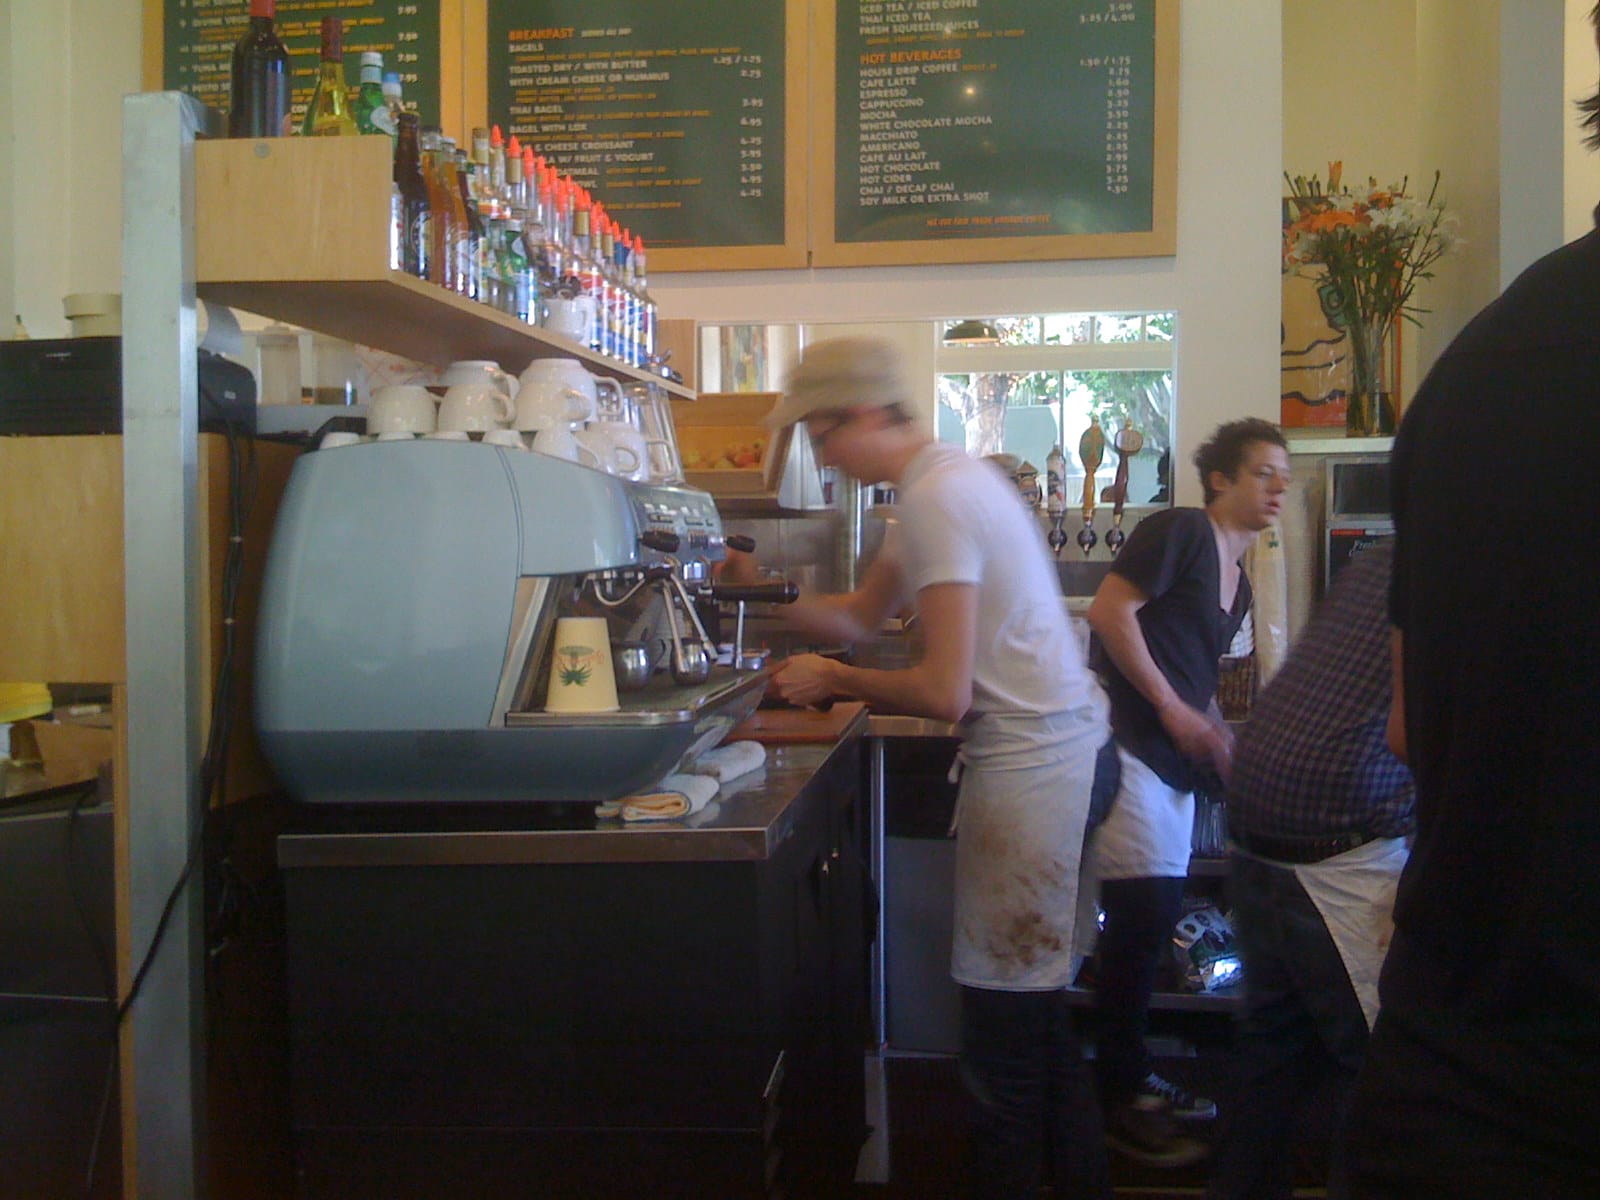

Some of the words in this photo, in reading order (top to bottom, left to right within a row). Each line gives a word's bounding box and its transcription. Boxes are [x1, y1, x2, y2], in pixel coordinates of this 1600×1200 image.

[886, 3, 904, 12] TEA
[916, 0, 939, 10] ICED
[943, 0, 978, 8] COFFEE
[886, 13, 908, 22] ICED
[912, 12, 931, 21] TEA
[893, 22, 943, 34] SQUEEZED
[509, 44, 544, 52] BAGELS
[860, 53, 886, 64] HOT
[890, 49, 962, 62] BEVERAGES
[510, 64, 550, 74] TOASTED
[584, 62, 608, 70] WITH
[612, 60, 647, 69] BUTTER
[860, 68, 892, 77] HOUSE
[896, 66, 920, 75] DRIP
[922, 64, 958, 74] COFFEE
[510, 78, 533, 86] WITH
[536, 76, 569, 86] CREAM
[572, 74, 606, 84] CHEESE
[608, 74, 622, 82] OR
[860, 78, 884, 88] CAFE
[888, 77, 917, 86] LATTE
[860, 88, 908, 98] ESPRESSO
[534, 104, 563, 114] BAGEL
[860, 98, 924, 109] CAPPUCCINO
[860, 110, 896, 120] MOCHA
[860, 121, 890, 130] WHITE
[894, 118, 951, 129] CHOCOLATE
[954, 116, 992, 126] MOCHA
[510, 124, 538, 134] BAGEL
[542, 124, 565, 132] WITH
[860, 131, 918, 141] MACCHIATO
[544, 142, 578, 152] CHEESE
[582, 140, 634, 150] CROISSANT
[860, 142, 920, 152] AMERICANO
[575, 154, 600, 162] FRUIT
[615, 152, 654, 162] YOGURT
[860, 154, 885, 163] CAFE
[888, 152, 900, 161] AU
[905, 152, 927, 160] LAIT
[860, 164, 880, 174] HOT
[884, 161, 940, 172] CHOCOLATE
[860, 175, 880, 184] HOT
[883, 174, 912, 184] CIDER
[860, 186, 883, 196] CHAI
[896, 184, 928, 194] DECAF
[930, 182, 954, 192] CHAI
[860, 196, 880, 206] SOY
[882, 195, 907, 206] MILK
[910, 194, 924, 204] OR
[928, 193, 960, 203] EXTRA
[964, 192, 990, 201] SHOT
